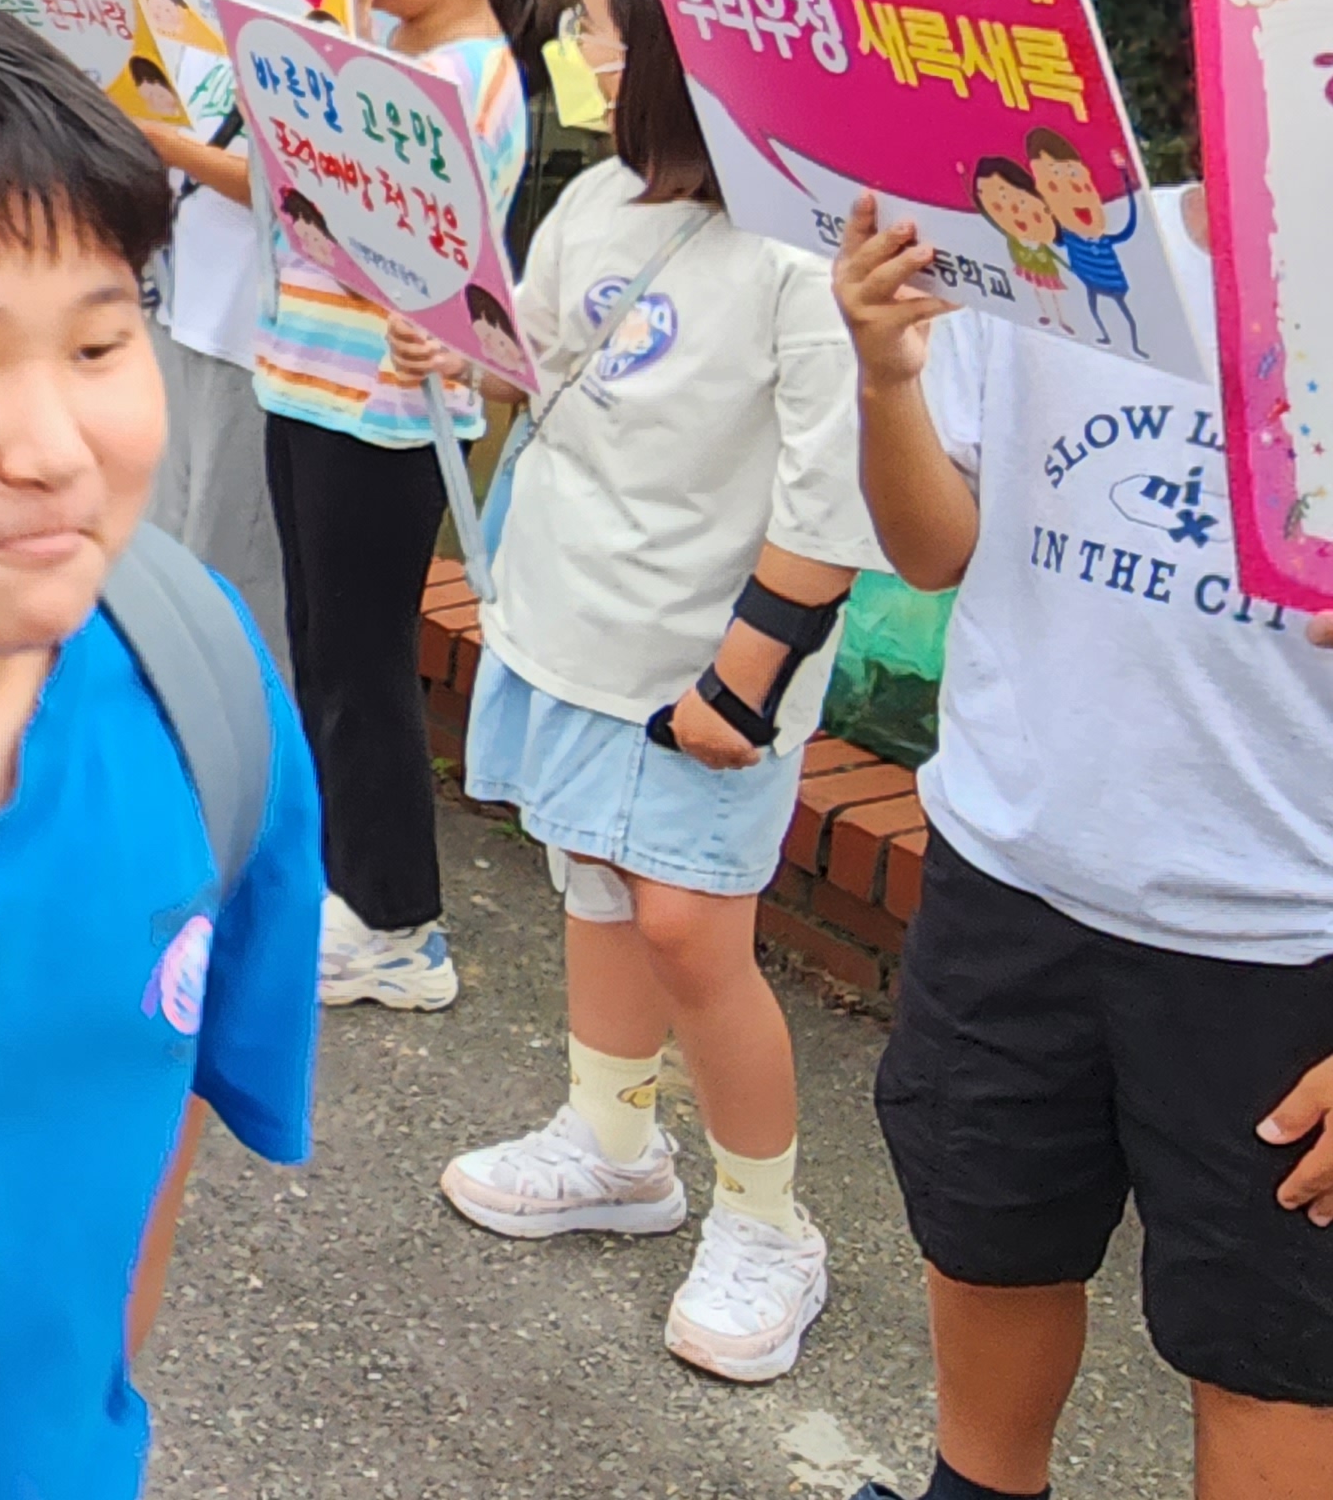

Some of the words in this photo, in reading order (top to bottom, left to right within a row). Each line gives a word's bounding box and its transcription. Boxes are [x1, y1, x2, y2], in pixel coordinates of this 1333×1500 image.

[249, 50, 344, 134] 바른말
[355, 89, 452, 184] 고운말
[1044, 405, 1174, 489] SLOW
[1031, 525, 1069, 573] IN
[1079, 539, 1178, 603] THE
